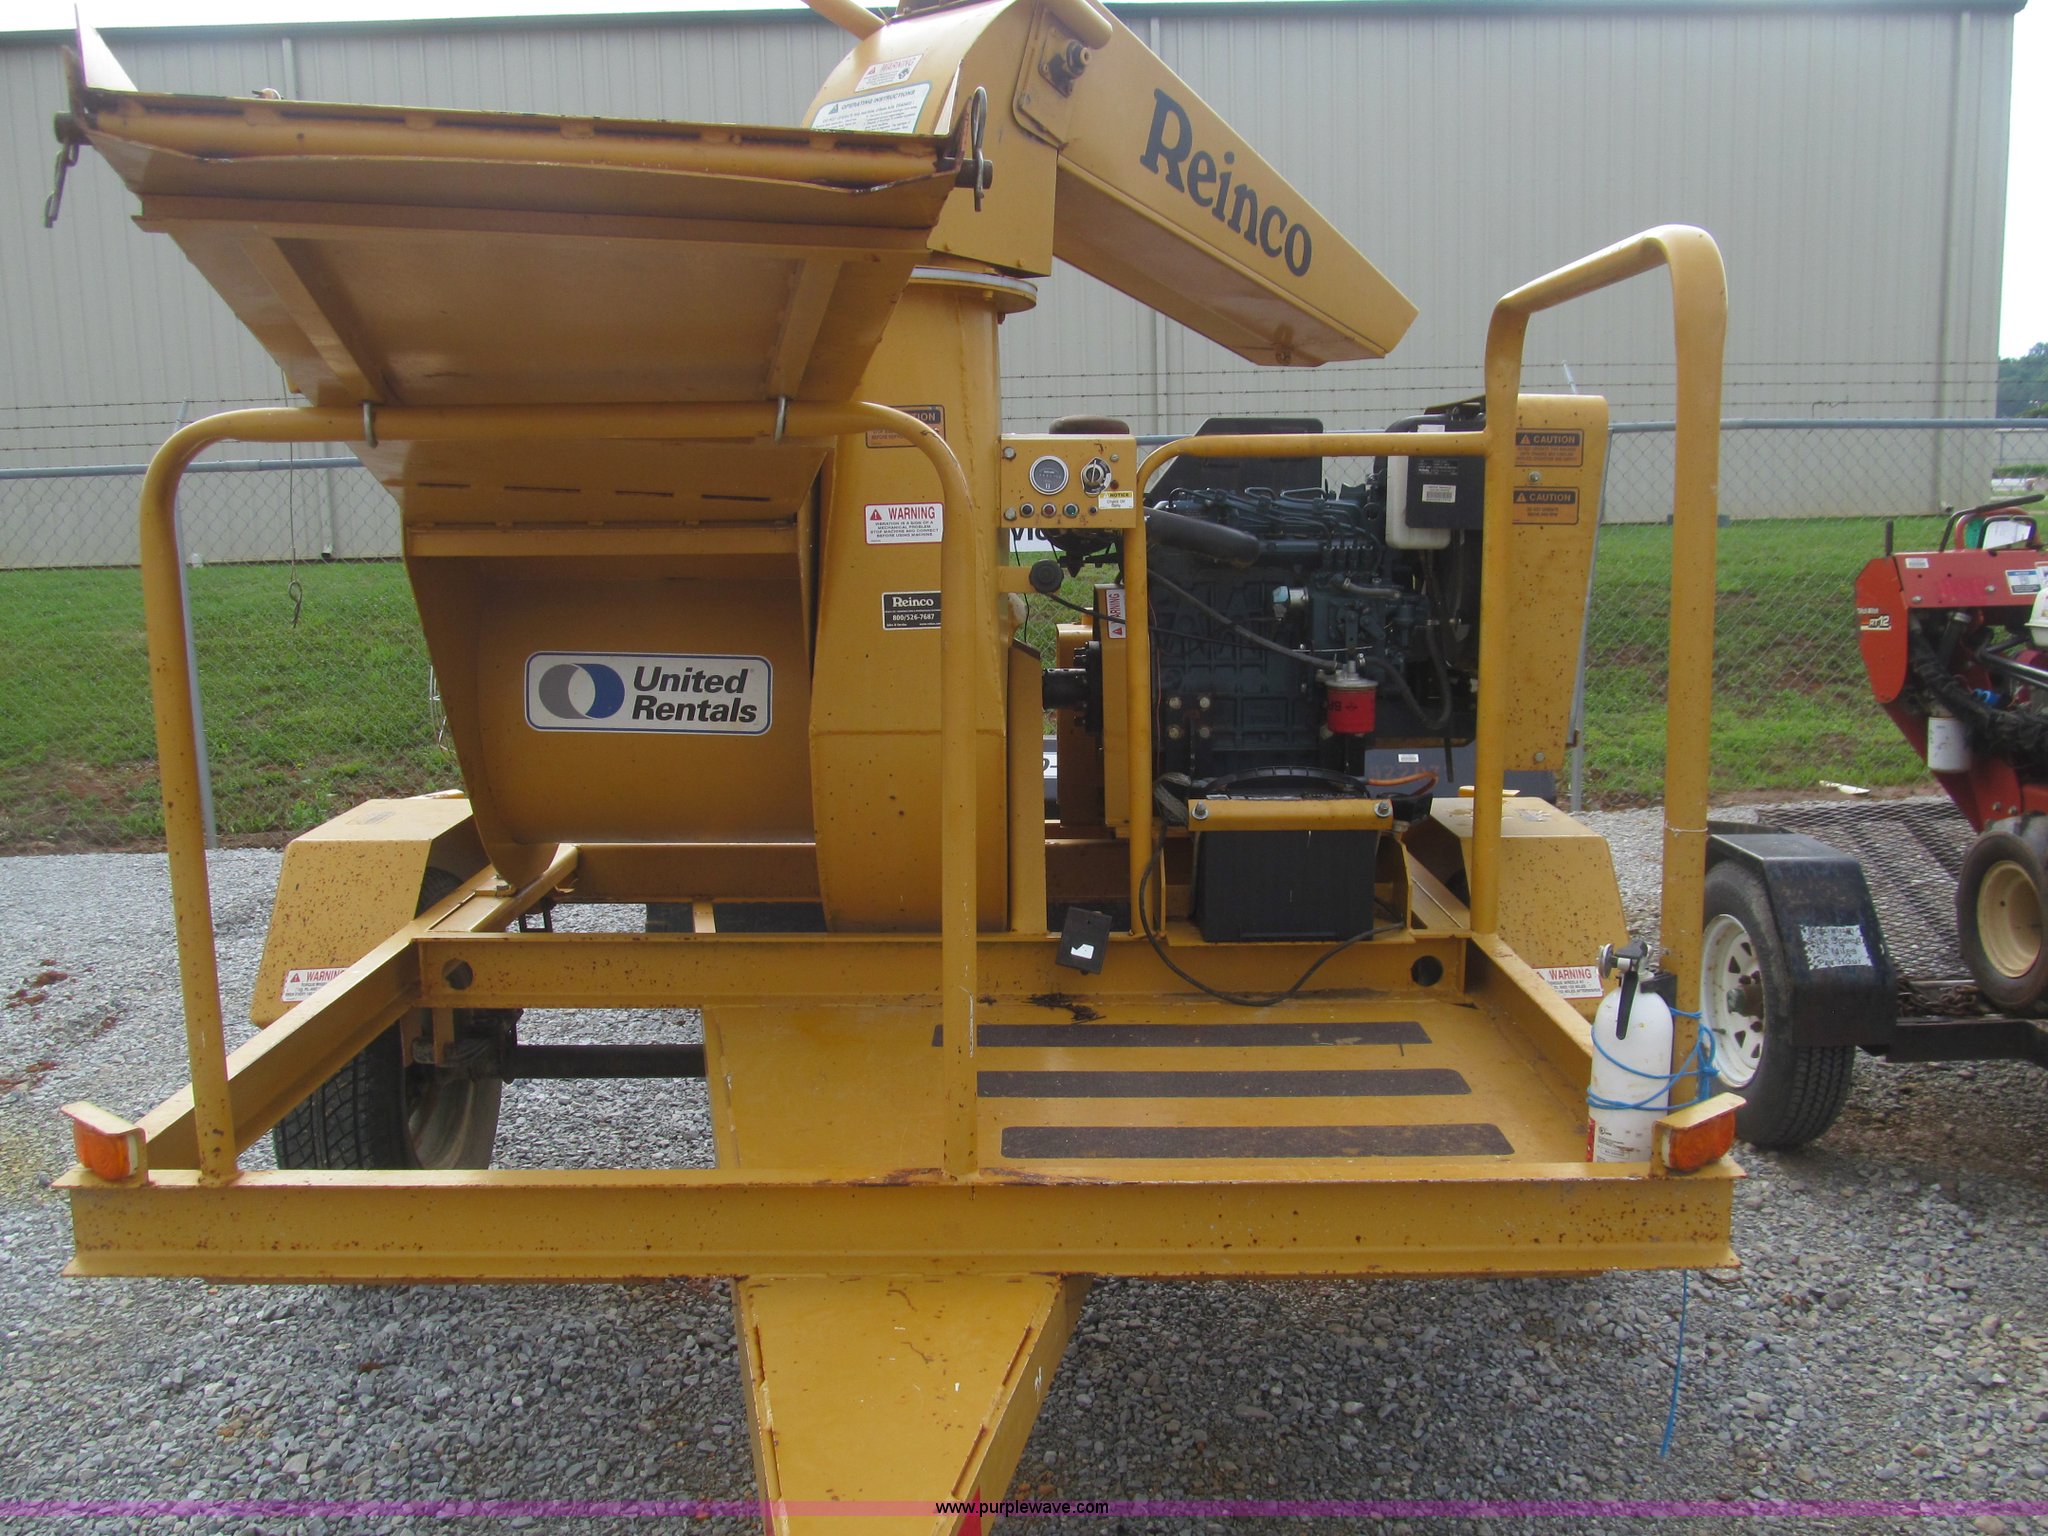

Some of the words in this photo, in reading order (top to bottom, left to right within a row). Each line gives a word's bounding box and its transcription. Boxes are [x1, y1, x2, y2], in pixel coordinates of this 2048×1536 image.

[1140, 88, 1312, 277] Reinco
[911, 412, 936, 422] TION
[1533, 435, 1575, 444] CAUTION
[1529, 493, 1571, 502] CAUTION
[888, 506, 936, 520] WARNING
[892, 596, 934, 608] Reinco
[1108, 593, 1121, 619] ARNING
[632, 666, 749, 694] United
[631, 695, 758, 723] Rentals
[306, 970, 342, 982] WARNIN
[1548, 968, 1592, 980] WARNING
